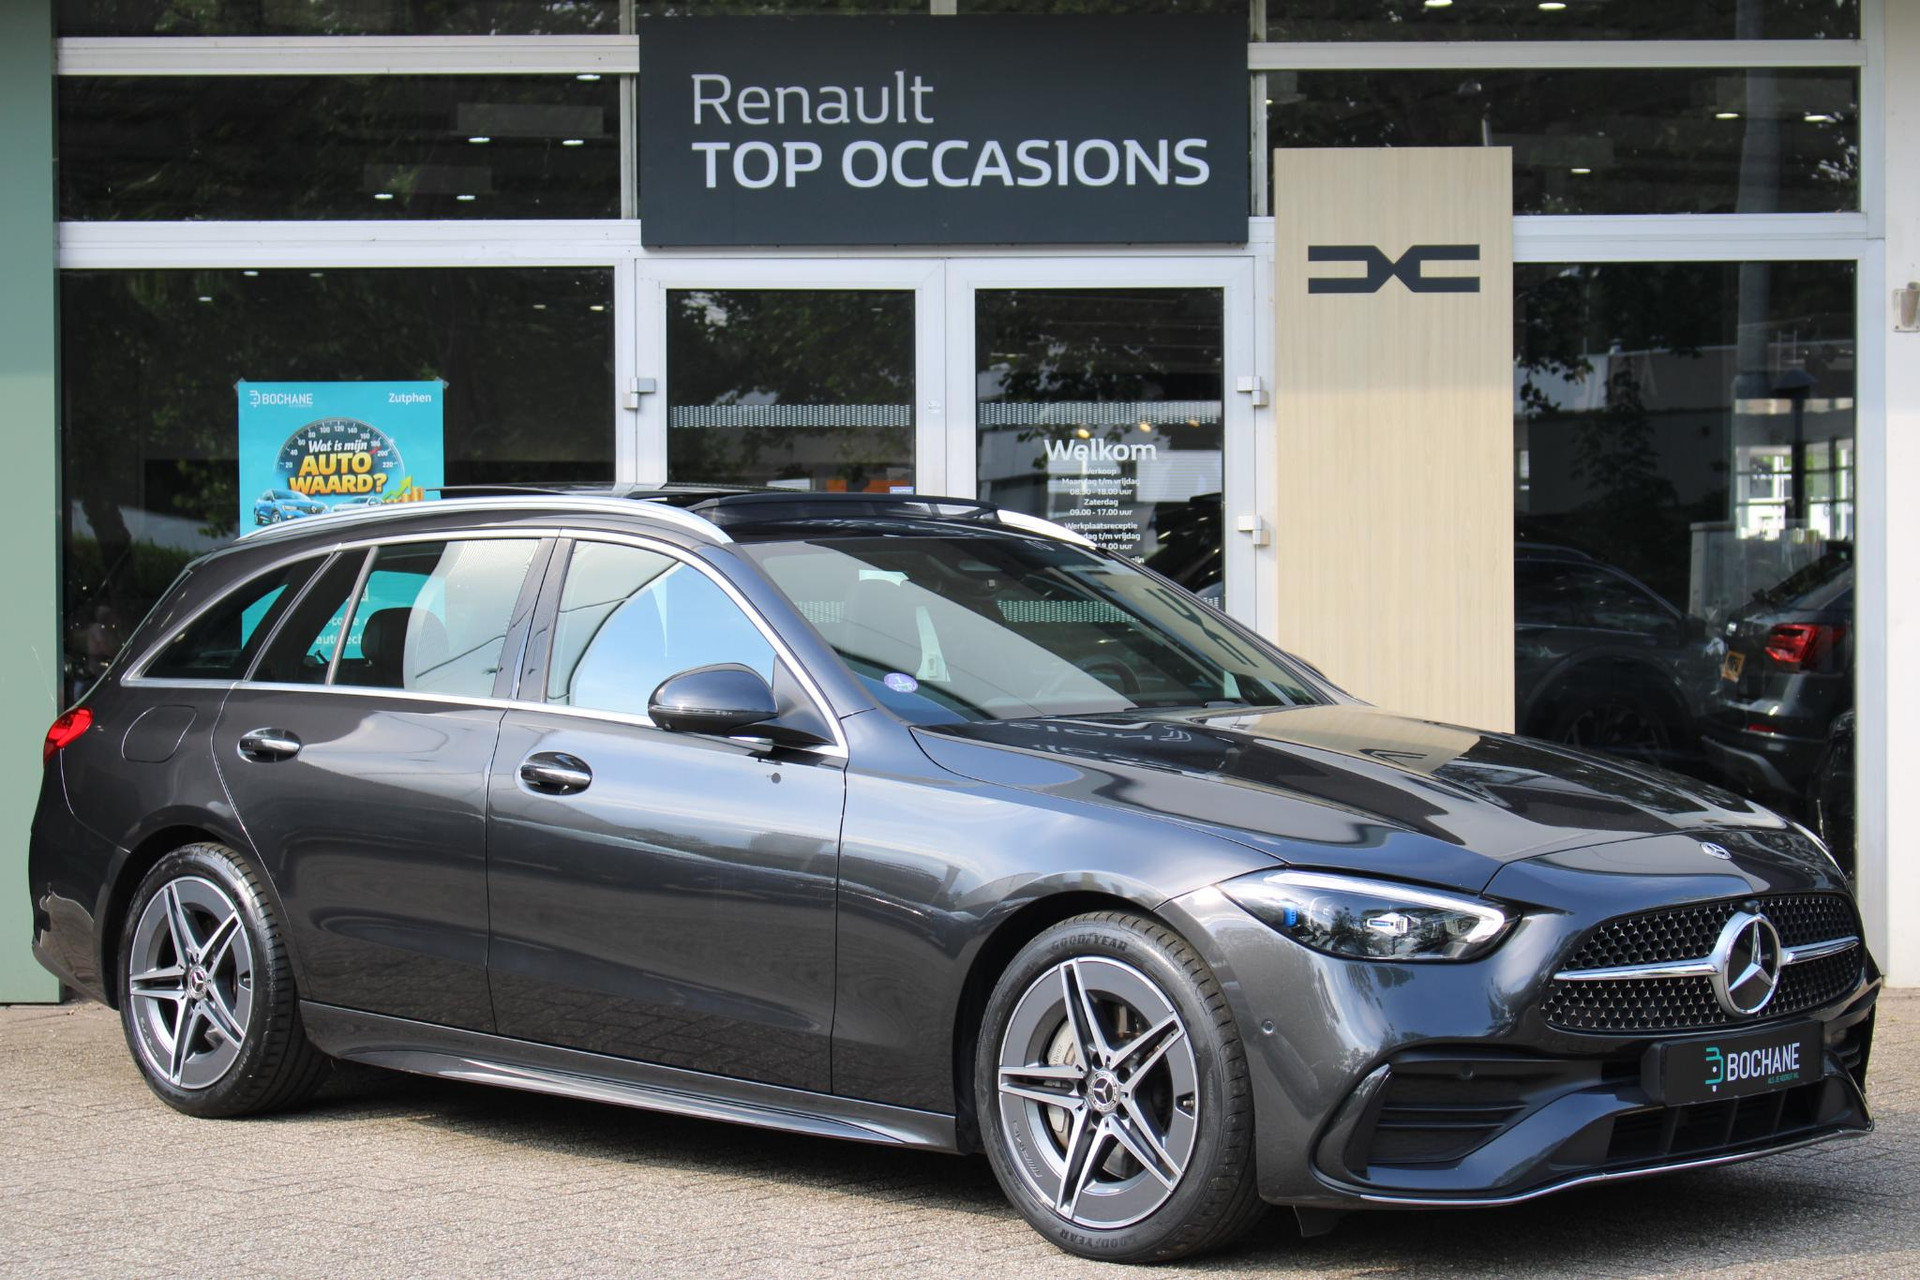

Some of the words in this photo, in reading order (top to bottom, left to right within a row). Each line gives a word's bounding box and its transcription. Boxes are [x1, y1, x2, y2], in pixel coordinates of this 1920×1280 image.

[691, 71, 934, 125] Renault
[691, 141, 823, 189] TOP
[841, 138, 1211, 188] OCCASIONS
[262, 393, 314, 405] BOCHANE
[388, 392, 432, 405] Zutphen
[320, 426, 330, 434] 100
[347, 426, 358, 434] 140
[308, 440, 331, 453] Wat
[333, 441, 342, 451] is
[343, 440, 368, 453] mijn
[1044, 438, 1158, 461] Welkom
[290, 448, 298, 456] 40
[298, 452, 373, 477] AUTO
[1086, 467, 1117, 476] Verkoop
[289, 473, 388, 495] WAARD?
[1098, 478, 1113, 486] t/m
[1114, 478, 1141, 487] vrijdag
[1097, 488, 1118, 496] 18.00
[1084, 498, 1119, 507] Zaterdag
[1069, 508, 1092, 516] 09.00
[1097, 508, 1118, 516] 17.00
[1065, 521, 1138, 530] Werkplaatsreceptie
[1099, 532, 1113, 540] t/m
[1114, 532, 1141, 541] vrijdag
[1727, 1042, 1800, 1081] BOCHANE
